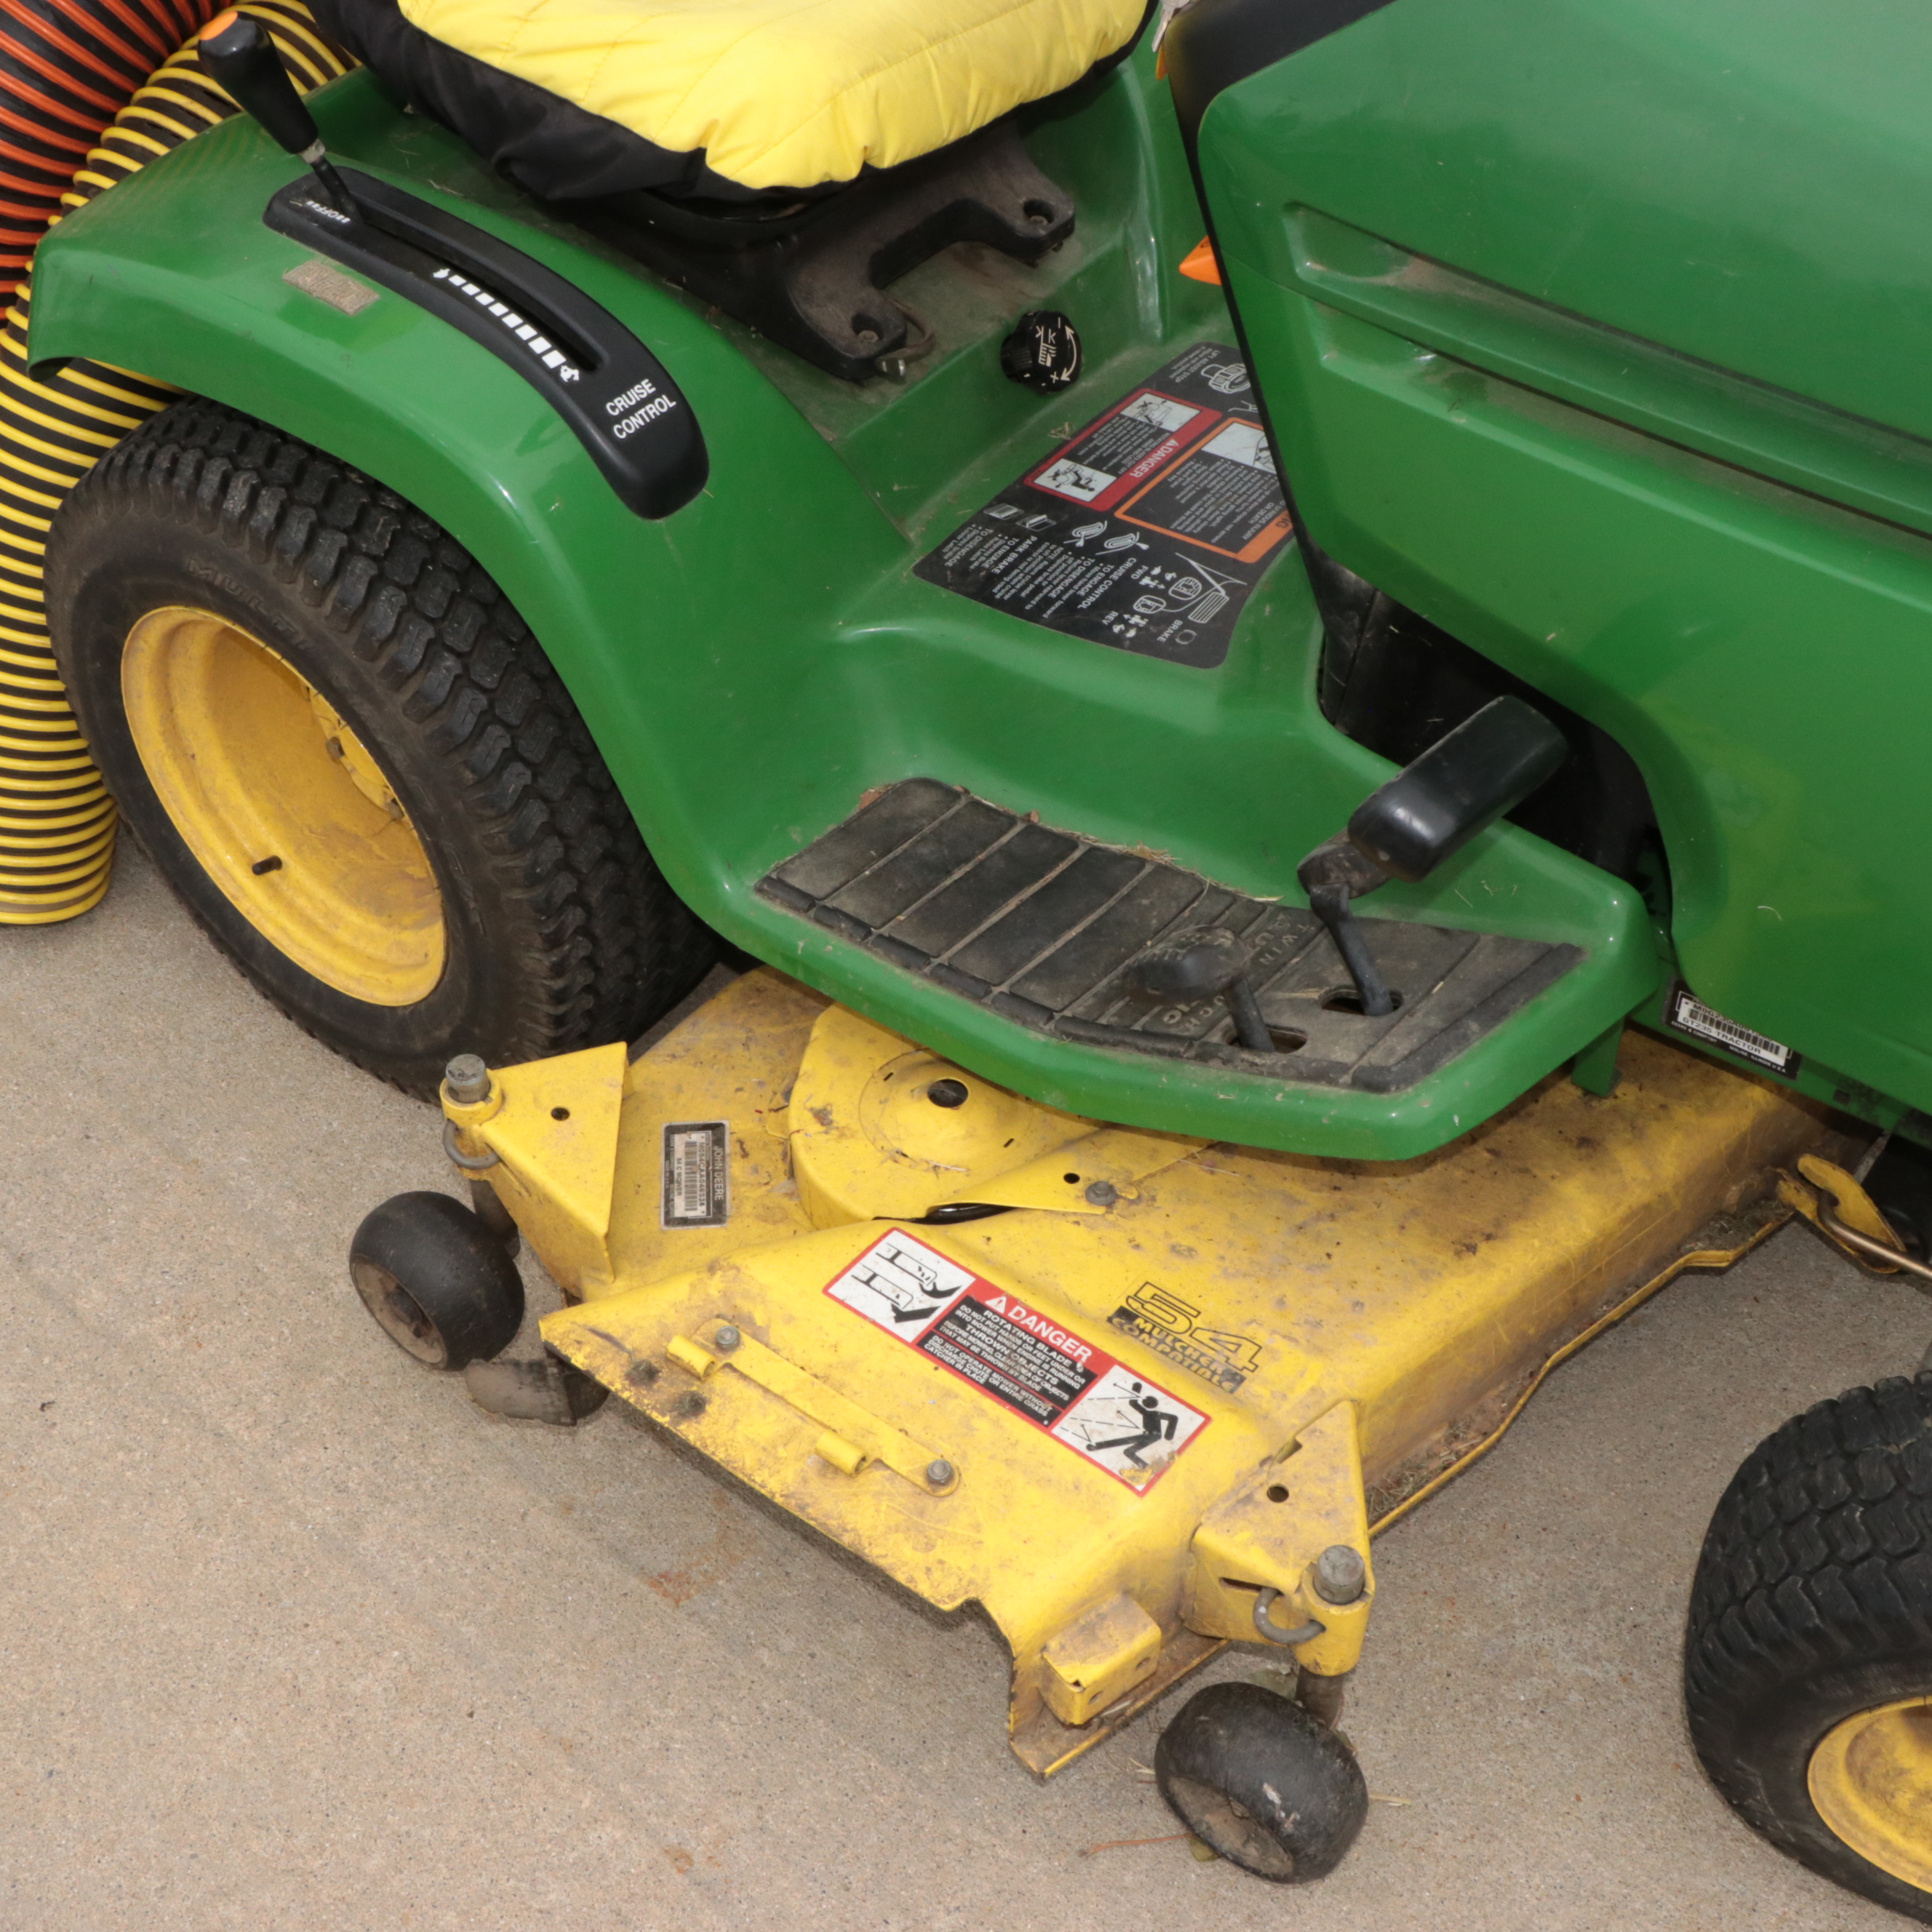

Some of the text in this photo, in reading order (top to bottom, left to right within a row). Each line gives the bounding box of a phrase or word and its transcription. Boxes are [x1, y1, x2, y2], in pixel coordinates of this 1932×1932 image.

[314, 207, 339, 218] OFF
[606, 378, 656, 416] CRUISE
[613, 394, 676, 439] CONTROL
[1127, 445, 1175, 478] DANGER
[1246, 508, 1269, 524] DEATH
[1262, 501, 1275, 510] OR
[939, 527, 973, 552] Lower Latch
[940, 529, 981, 559] Depress Brake
[941, 527, 994, 567] TO DISENGAGE
[967, 538, 1007, 570] Depress Brake
[978, 537, 1020, 569] TO ENGAGE
[989, 535, 1039, 574] PARK BRAKE
[1017, 554, 1070, 597] Depress brake pedal
[1043, 562, 1069, 580] position
[1044, 557, 1095, 599] TO DISENGAGE
[1050, 573, 1066, 585] lever
[1061, 559, 1083, 574] Return
[1073, 563, 1116, 596] TO ENGAGE
[1074, 556, 1139, 610] CRUISE CONTROL
[1127, 564, 1150, 580] FWD
[1028, 584, 1056, 604] rearward
[1039, 566, 1101, 618] Move hand lever forward
[1098, 610, 1120, 625] REV
[1153, 619, 1186, 642] BRAKE
[1682, 1017, 1760, 1054] GT235 TRACTOR
[714, 1146, 724, 1200] JOHN DEERE
[959, 1304, 1087, 1384] DO NOT PUT HANDS OR FEET UNDER OR
[982, 1309, 1073, 1367] ROTATING BLADE
[1006, 1304, 1095, 1362] DANGER
[1126, 1282, 1263, 1373] 54
[1133, 1317, 1224, 1375] MULCHER
[923, 1342, 986, 1384] CATCHER IN PLACE
[938, 1325, 1042, 1392] THAT MAY BE THROWN BY BLADE
[943, 1320, 970, 1338] BEFORE
[992, 1351, 1016, 1368] CLEAR
[1013, 1364, 1033, 1378] AREA
[1029, 1374, 1042, 1384] OF
[1039, 1380, 1070, 1402] OBJECTS
[954, 1309, 1082, 1389] INTO MOWER WHEN ENGINE IS RUNNING
[963, 1323, 1060, 1386] THROWN OBJECTS
[1111, 1317, 1235, 1393] COMPATIBLE
[927, 1338, 1049, 1417] DISCHARGE CHUTE OR ENTIRE GRASS
[931, 1334, 1053, 1413] DO NOT OPERATE MOWER WITHOUT
